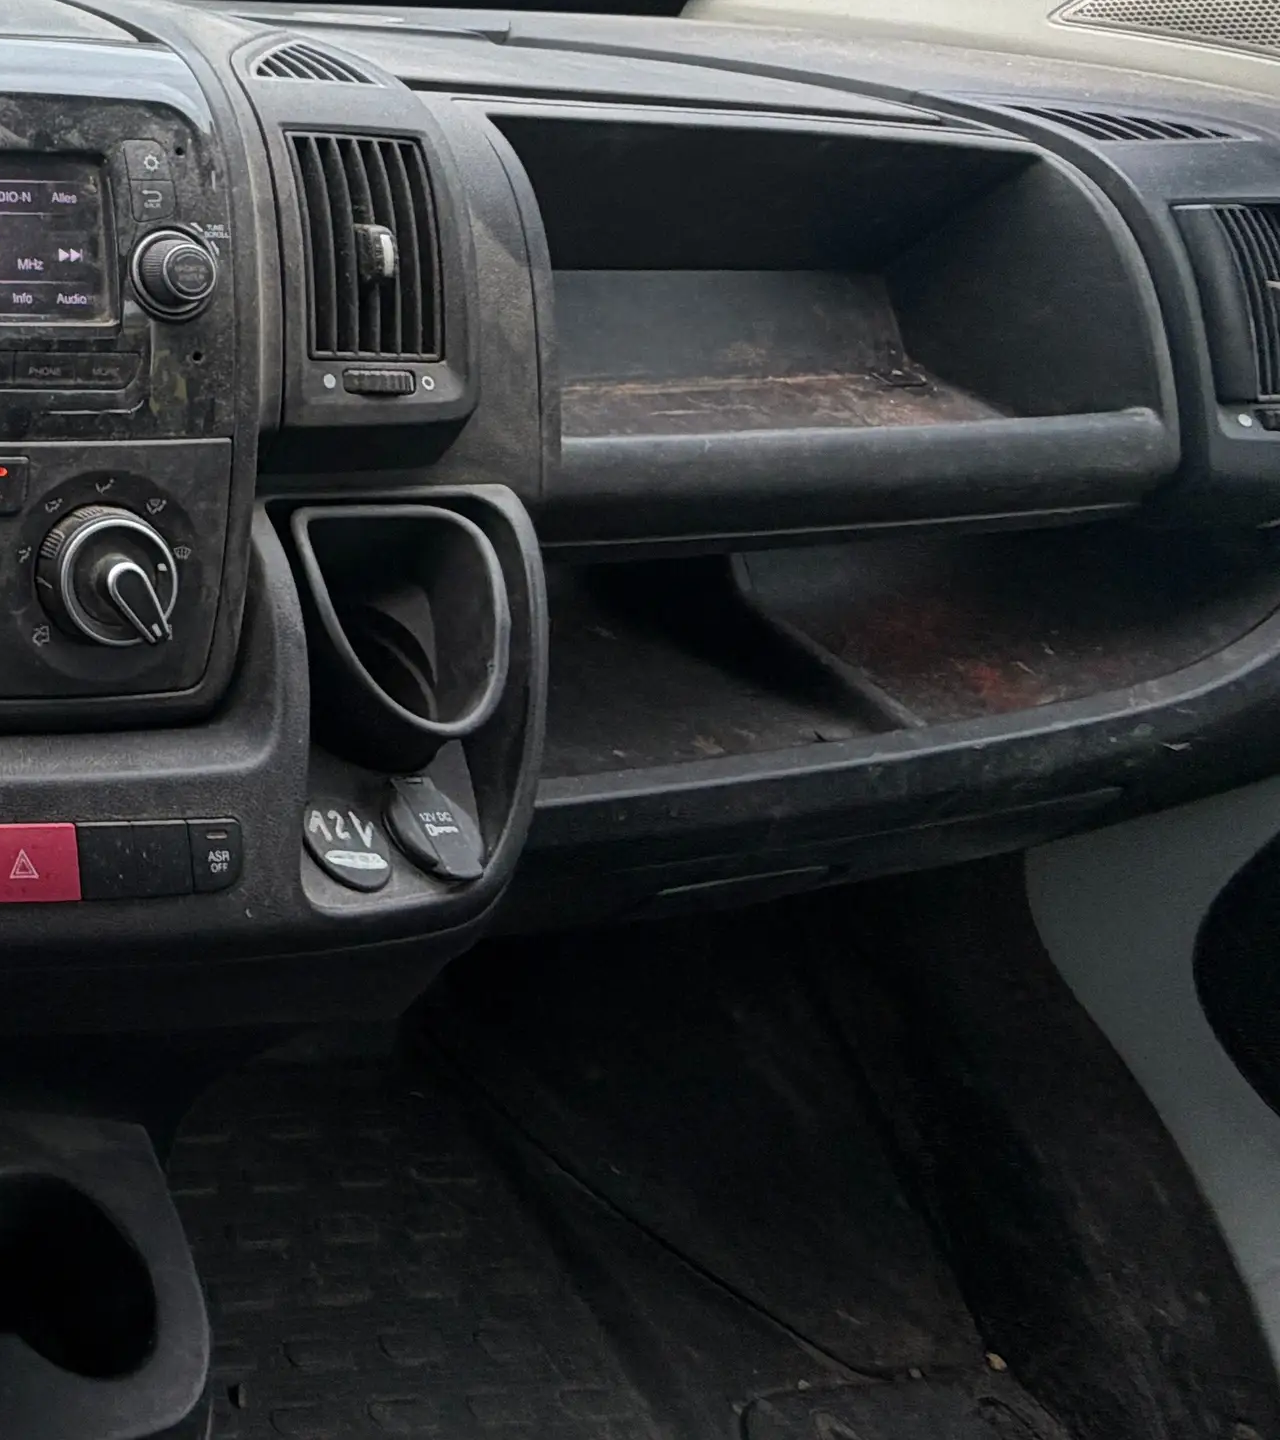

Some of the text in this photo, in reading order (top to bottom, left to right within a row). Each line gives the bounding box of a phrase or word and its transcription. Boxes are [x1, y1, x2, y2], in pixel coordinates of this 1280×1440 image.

[51, 192, 78, 204] Alles
[17, 257, 44, 271] MHz
[12, 291, 33, 304] Info
[56, 292, 88, 305] Audio
[208, 850, 230, 862] ASR
[210, 862, 228, 873] OFF
